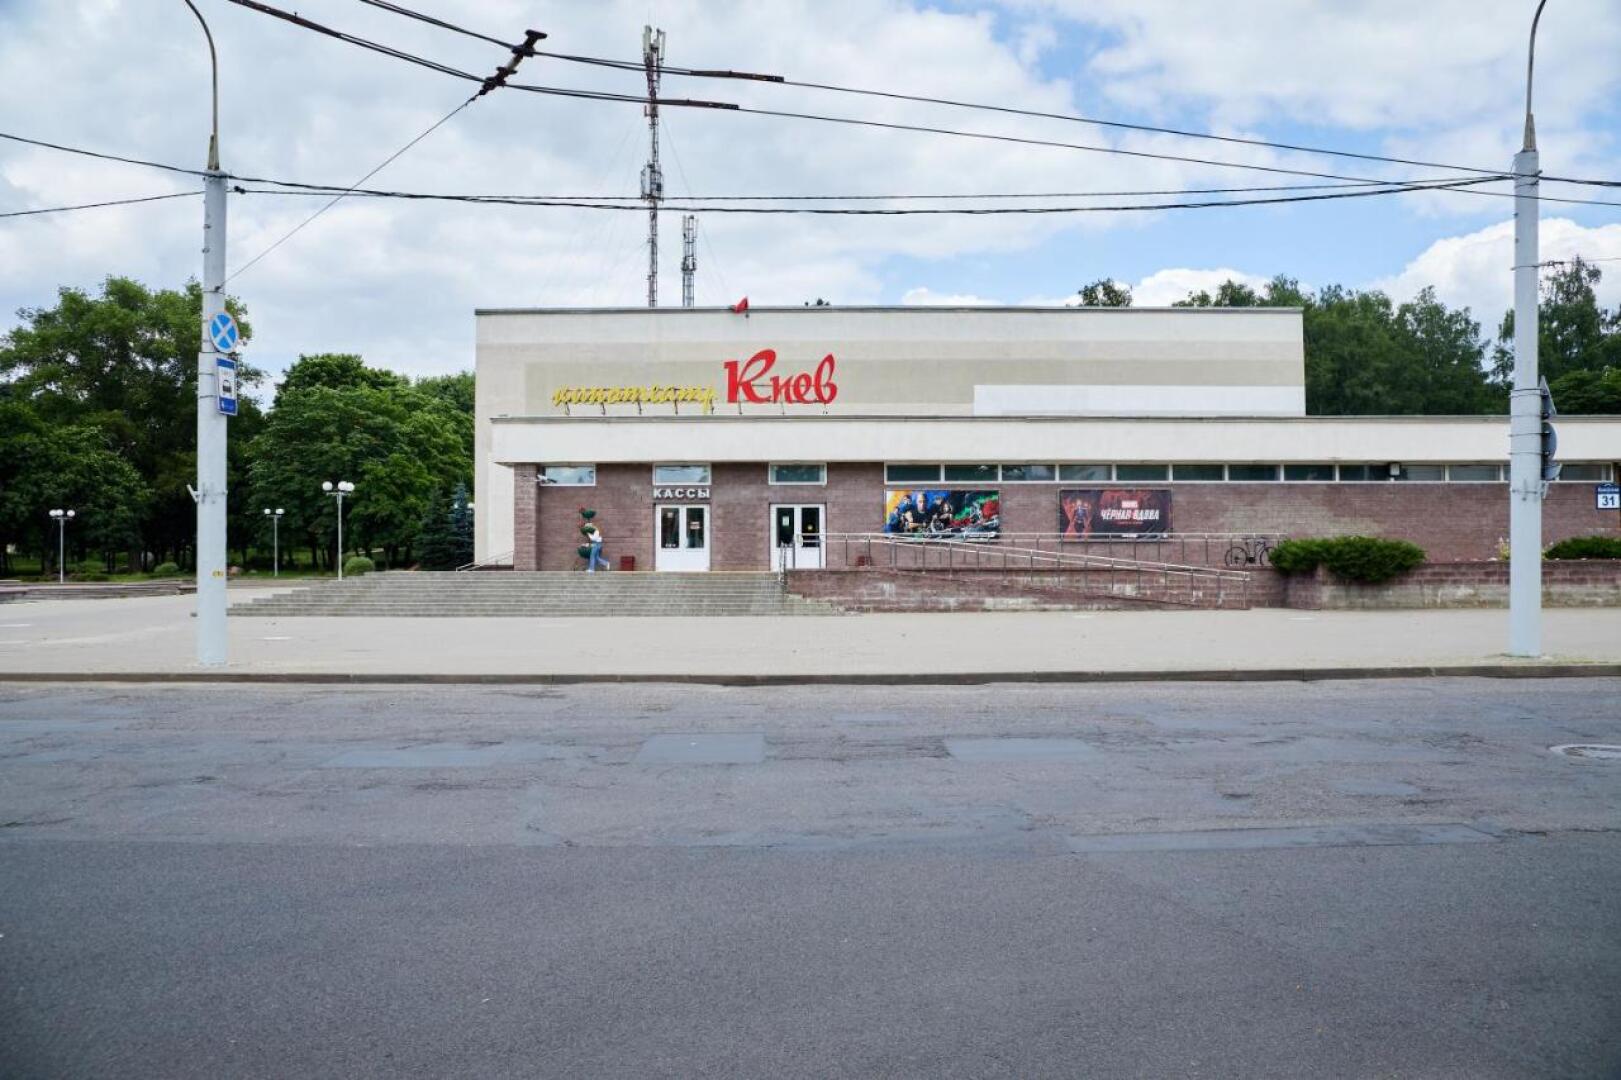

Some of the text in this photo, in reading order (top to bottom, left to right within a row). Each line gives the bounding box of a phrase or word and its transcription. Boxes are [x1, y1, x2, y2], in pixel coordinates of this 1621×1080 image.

[724, 349, 838, 404] Киев
[653, 488, 710, 499] КАССЫ
[1602, 495, 1615, 506] 31
